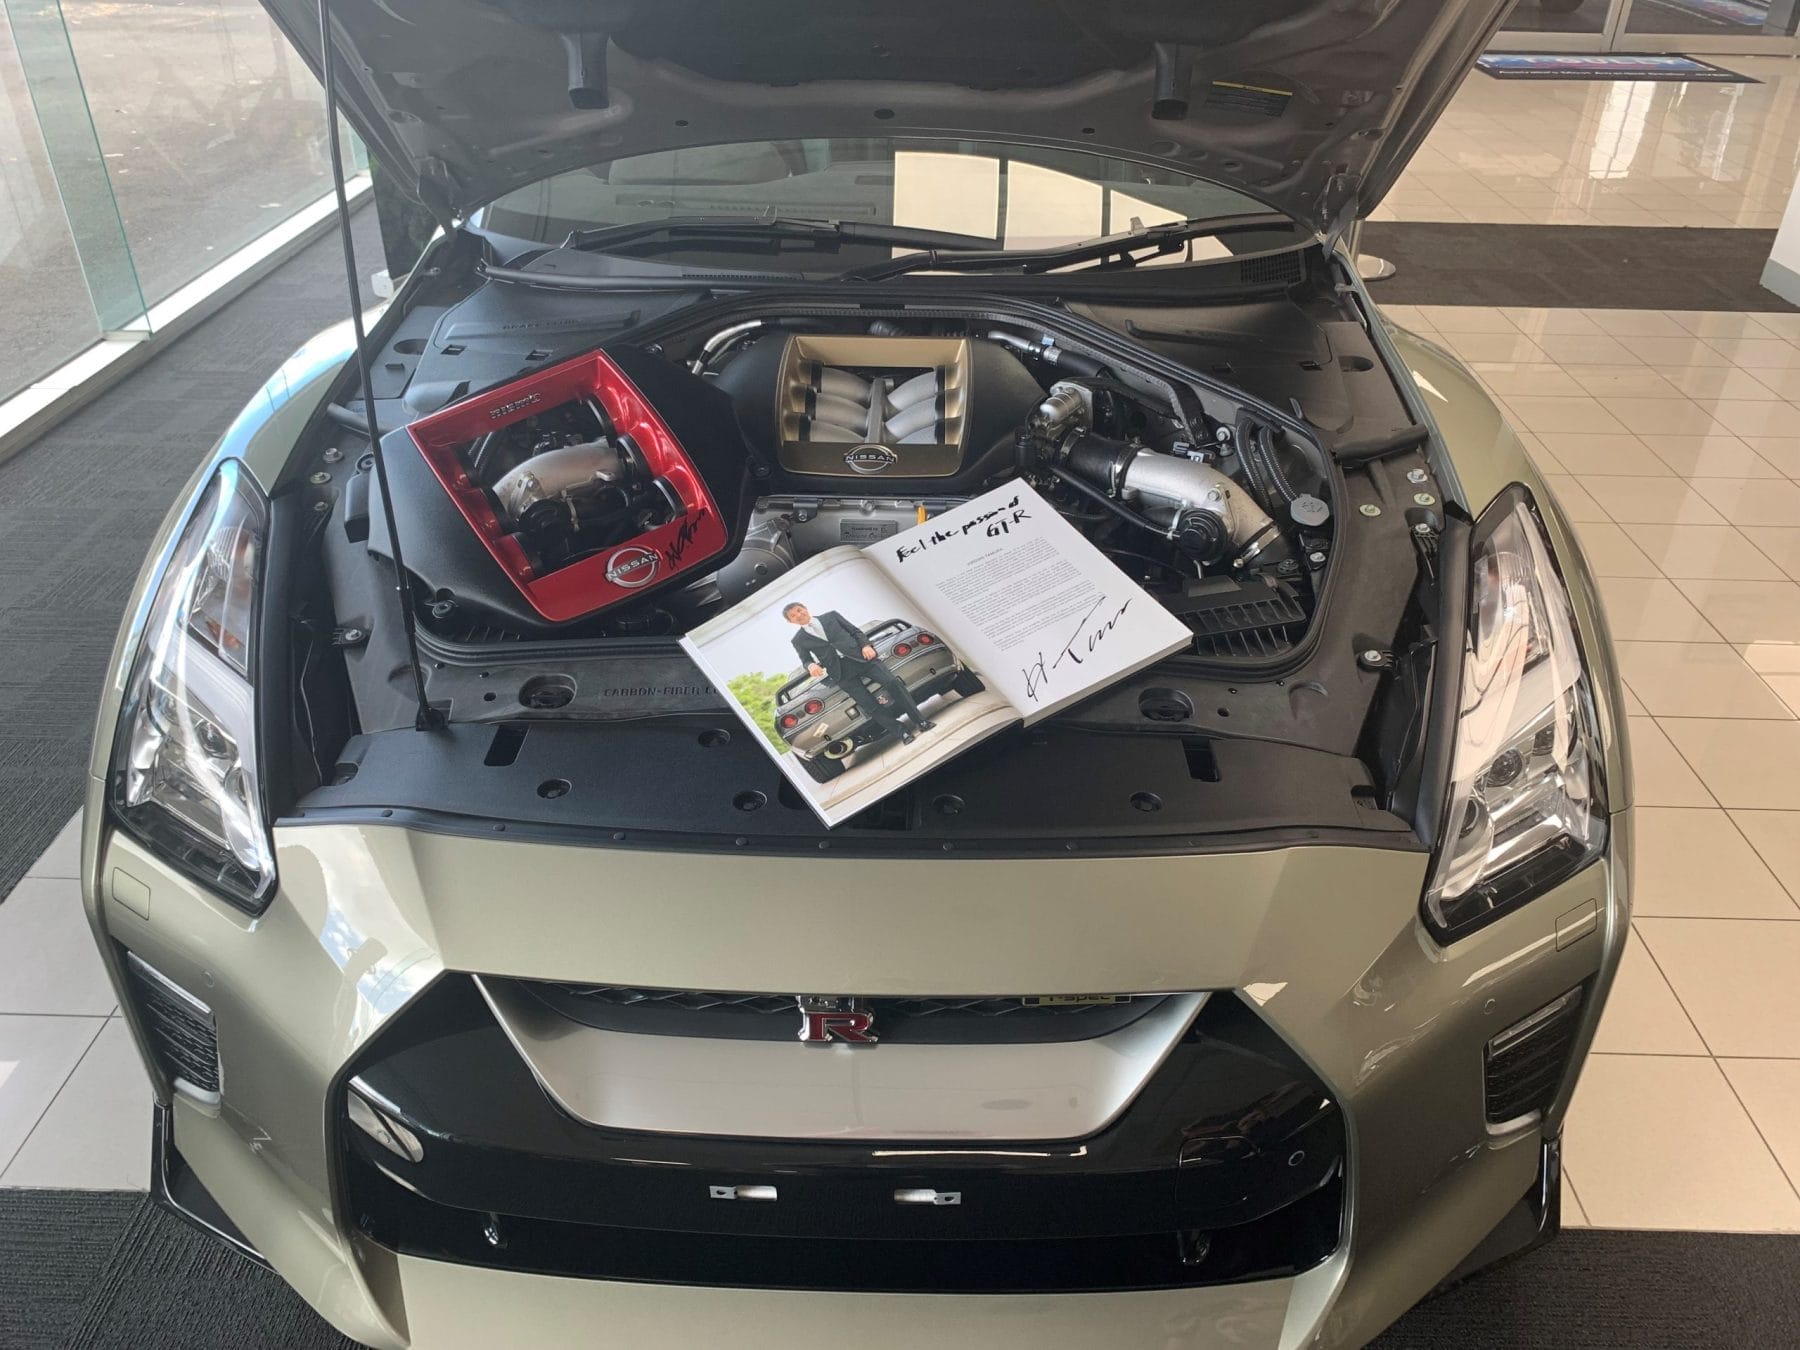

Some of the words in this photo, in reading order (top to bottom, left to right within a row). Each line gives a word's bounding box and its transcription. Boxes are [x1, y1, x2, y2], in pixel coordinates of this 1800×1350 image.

[845, 454, 895, 463] NISSAN
[930, 531, 959, 545] the
[606, 552, 659, 581] NISSAN
